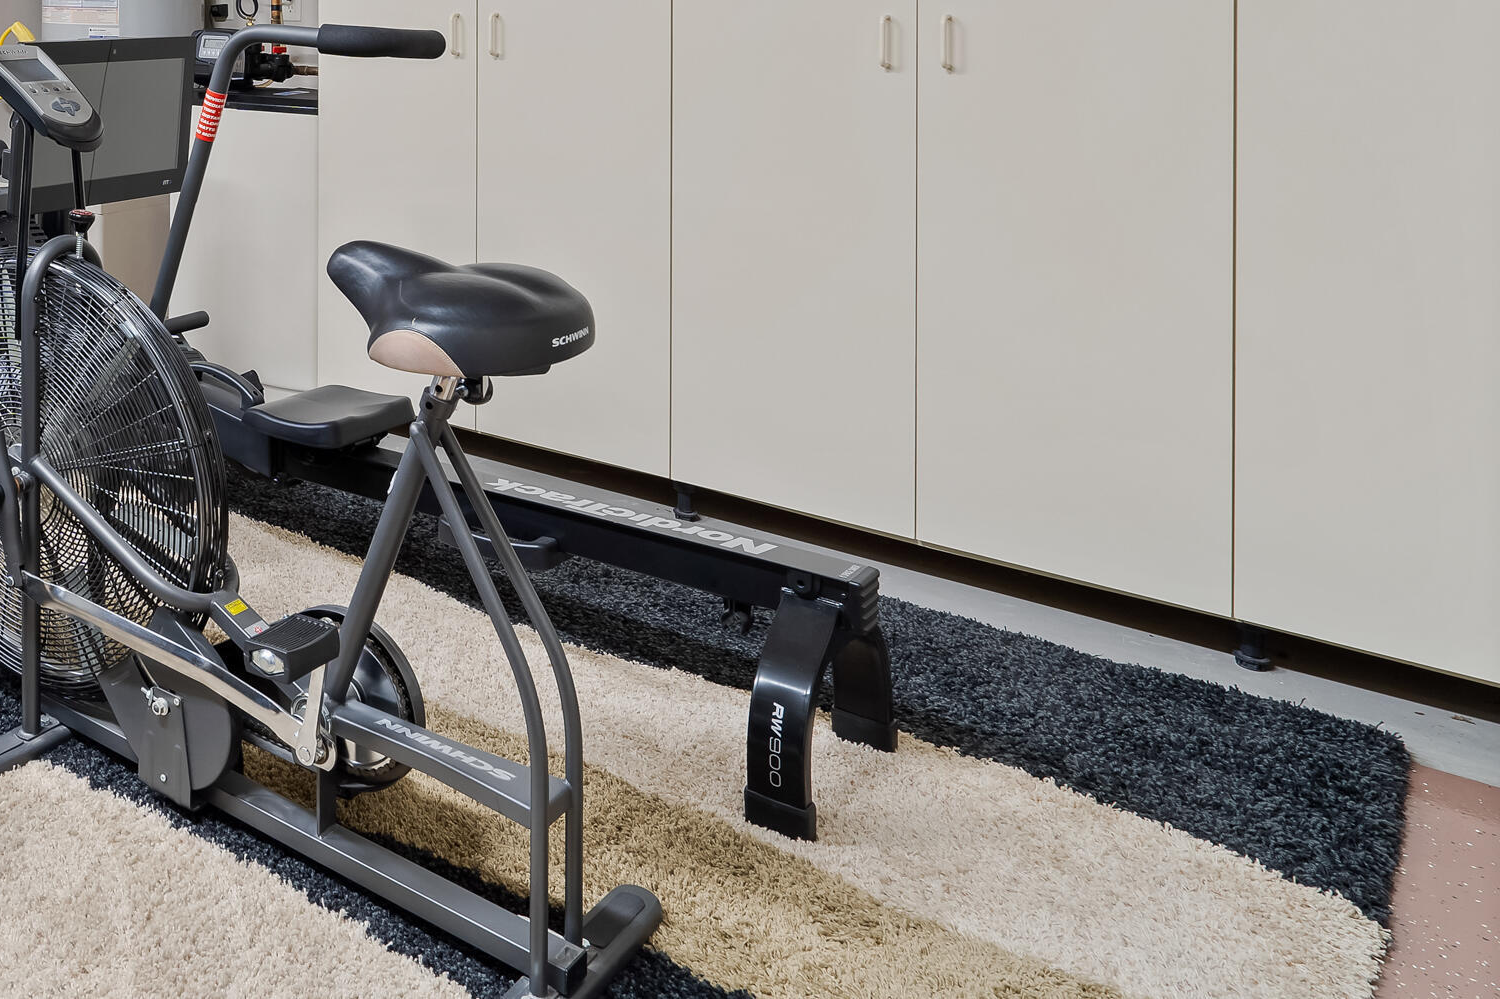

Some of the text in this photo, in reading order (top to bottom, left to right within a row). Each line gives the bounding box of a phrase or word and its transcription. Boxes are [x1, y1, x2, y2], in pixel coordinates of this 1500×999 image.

[552, 326, 589, 347] SCHWINN
[485, 478, 779, 555] NordicTrack
[374, 718, 517, 781] SCHWINN
[769, 702, 785, 787] RW900
